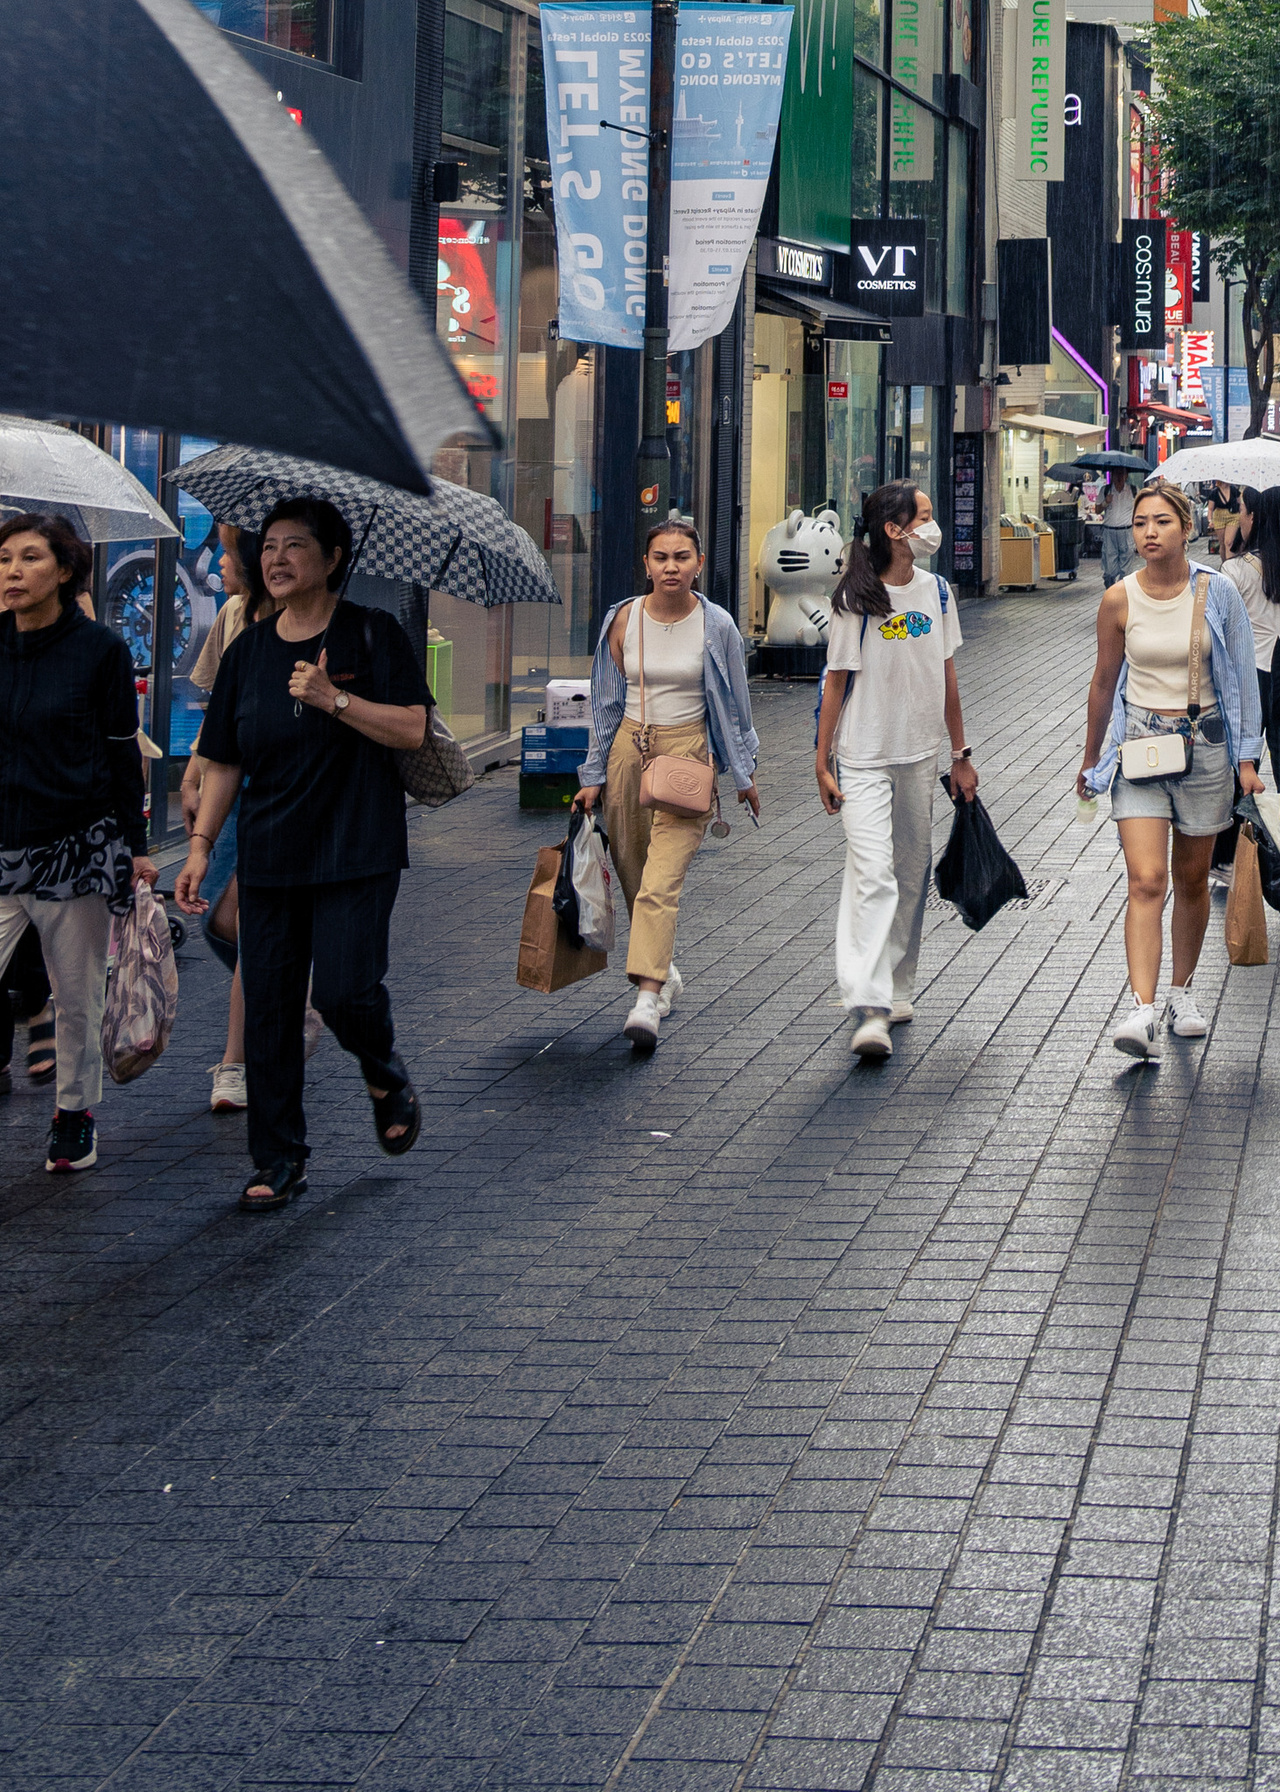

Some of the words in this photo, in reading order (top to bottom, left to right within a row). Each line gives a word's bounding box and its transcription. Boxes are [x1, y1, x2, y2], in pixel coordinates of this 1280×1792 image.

[1030, 57, 1050, 174] REPUBLIC
[858, 245, 917, 277] VT
[857, 280, 916, 290] COSMETICS
[1135, 234, 1152, 334] cos:mura
[1192, 628, 1201, 669] JACOBS
[1191, 672, 1199, 700] MARC
